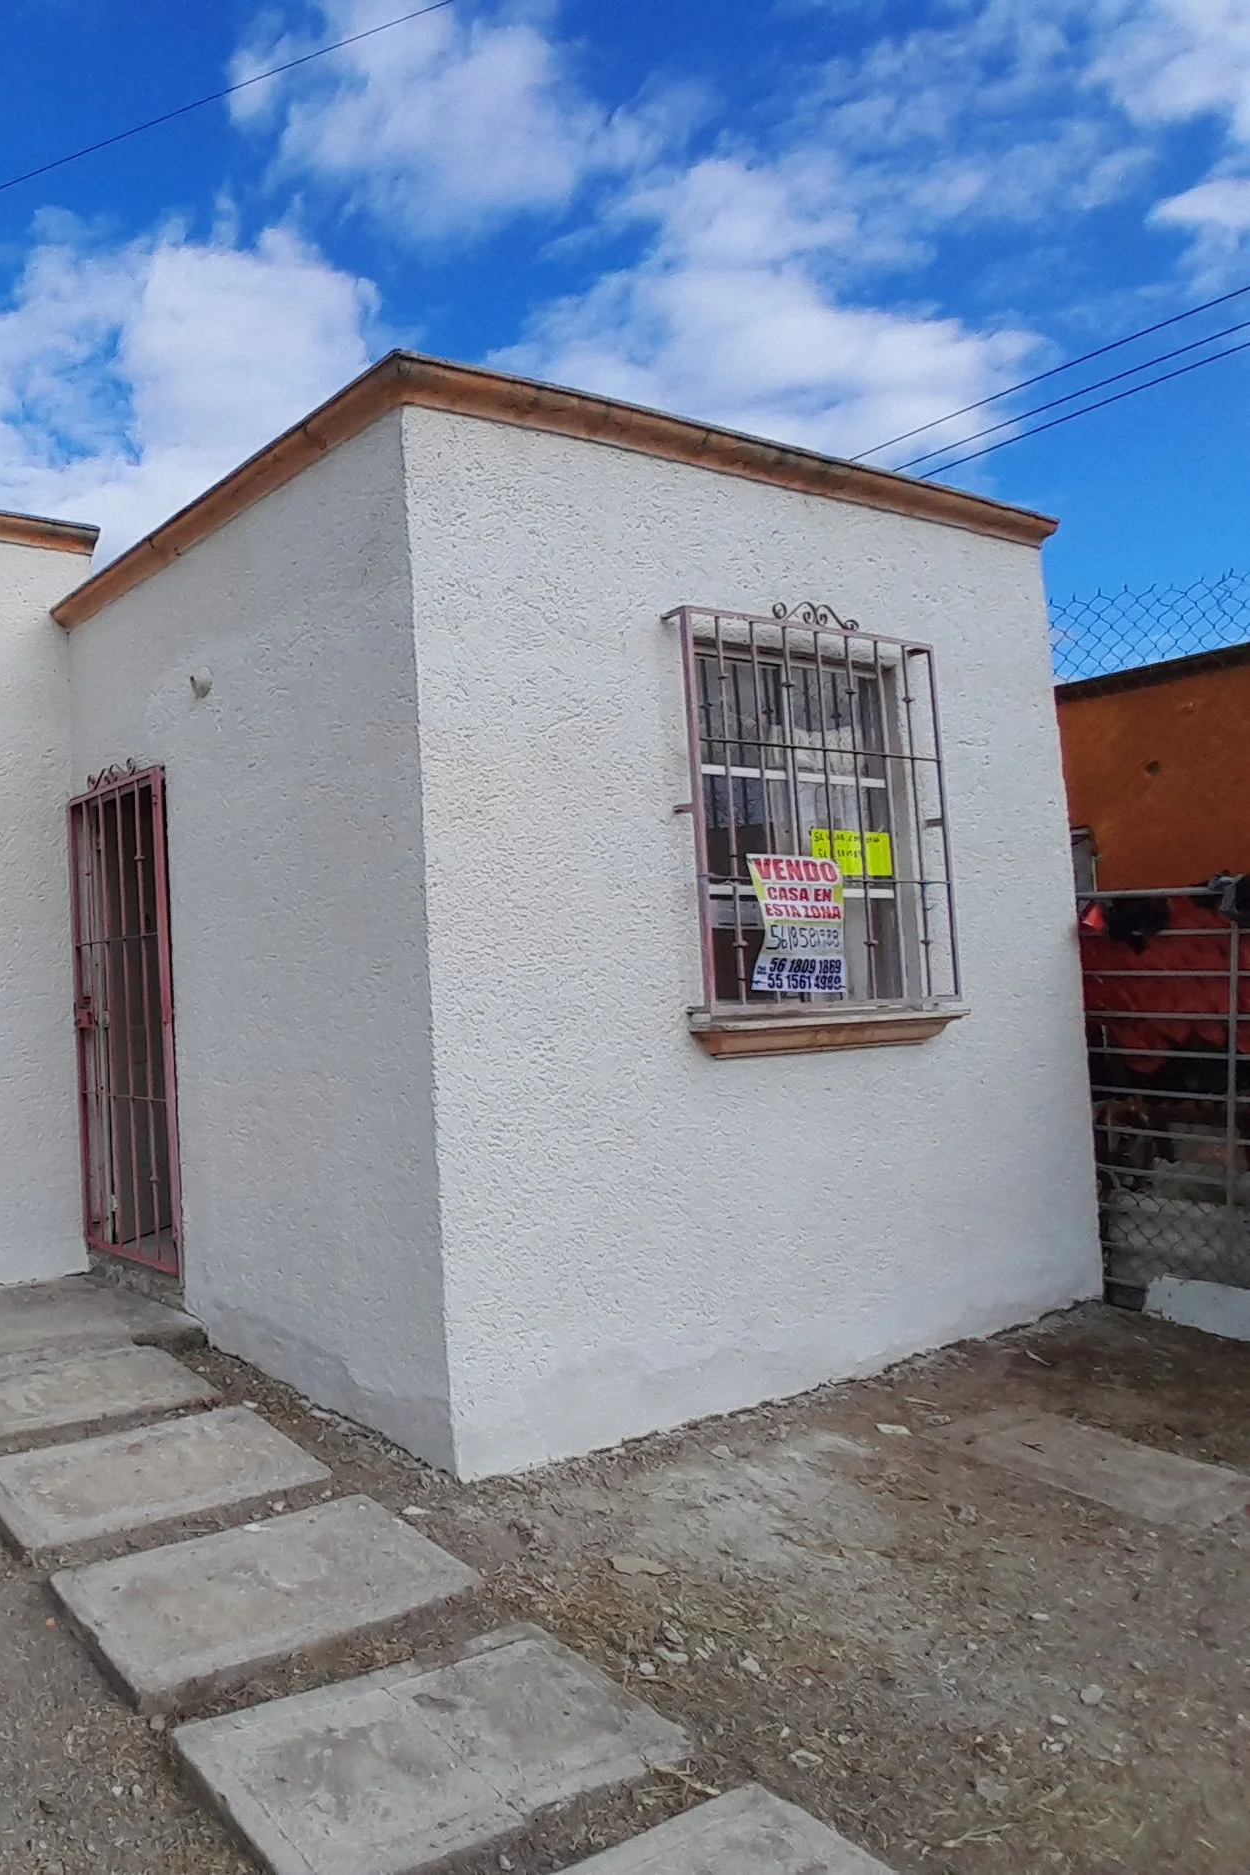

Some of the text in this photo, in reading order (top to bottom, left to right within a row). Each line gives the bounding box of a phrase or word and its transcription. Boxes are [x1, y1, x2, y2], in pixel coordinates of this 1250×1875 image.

[753, 857, 838, 883] VENDO
[767, 886, 832, 902] CASA EN
[764, 903, 841, 919] ESTA ZONA
[769, 957, 788, 973] 56
[788, 958, 816, 974] 1809
[767, 973, 783, 989] 55
[785, 974, 811, 990] 1561
